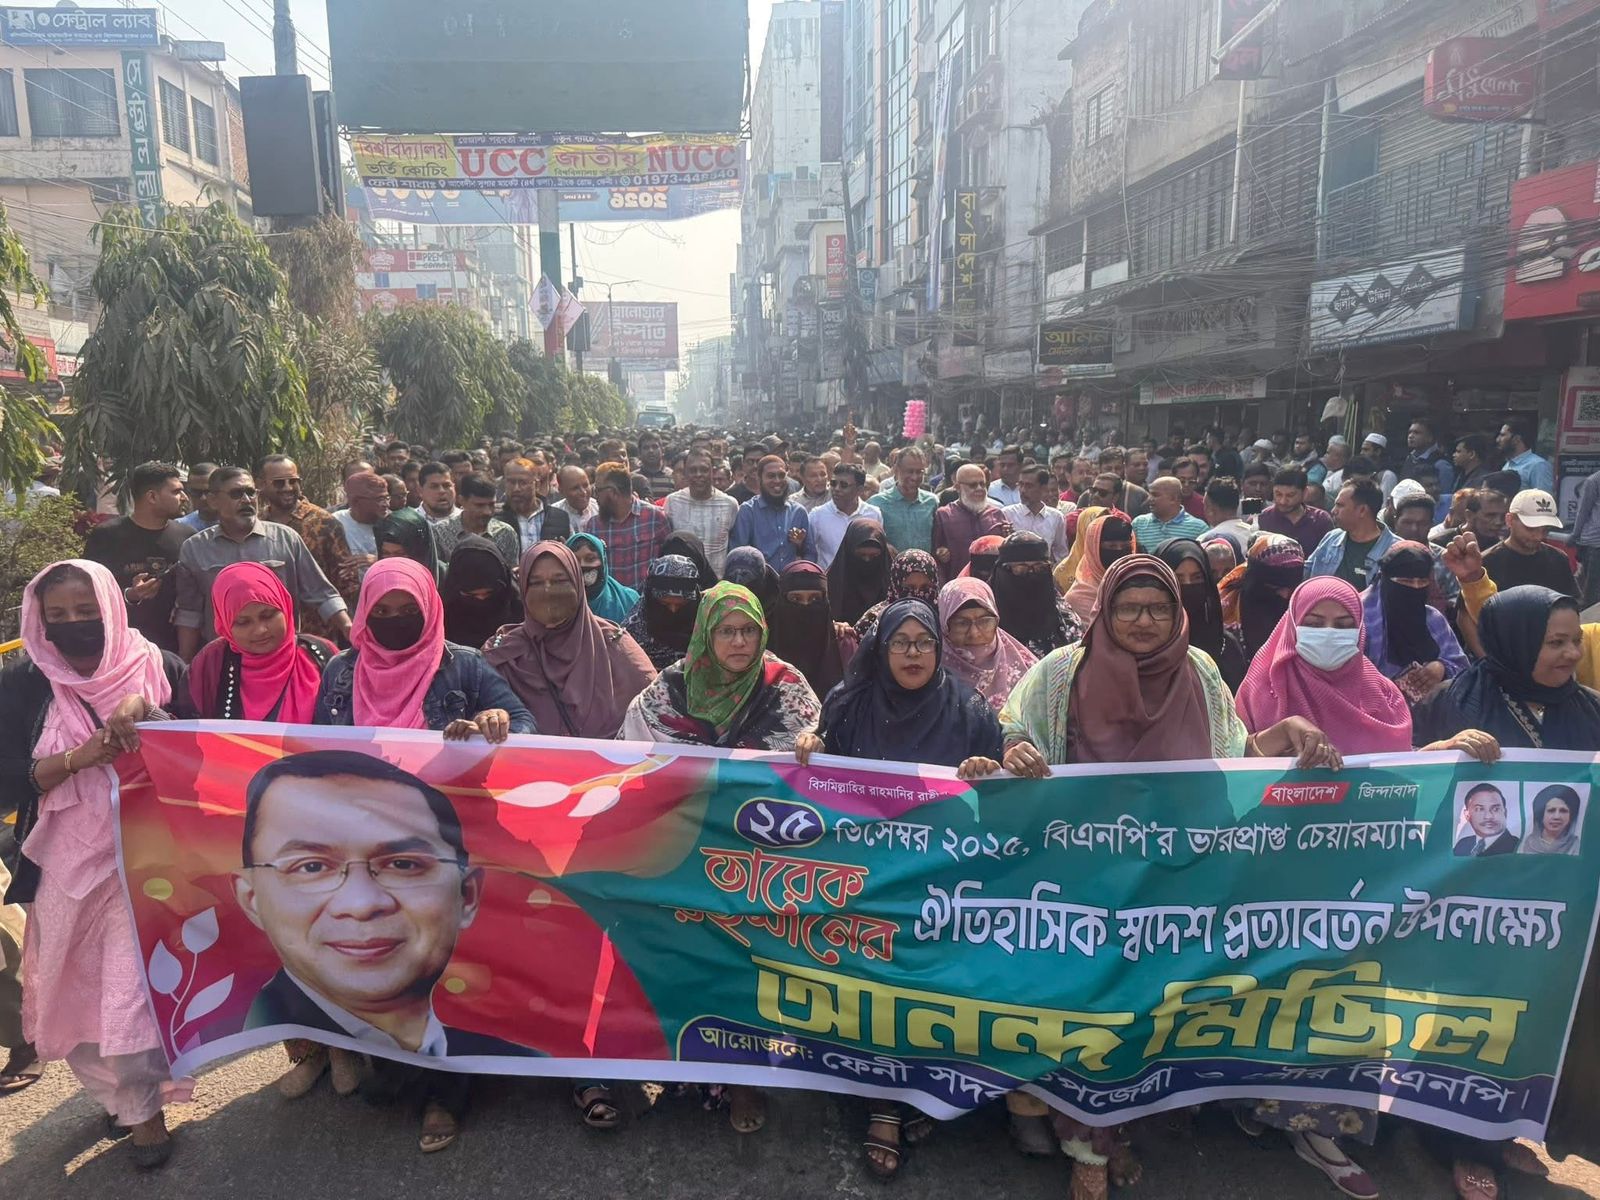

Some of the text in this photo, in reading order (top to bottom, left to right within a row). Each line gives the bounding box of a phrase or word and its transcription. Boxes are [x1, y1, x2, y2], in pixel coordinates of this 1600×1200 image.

[53, 9, 152, 31] সেন্ট্রাল ল্যাব
[355, 135, 448, 160] বিশ্ববিদ্যালয়
[554, 145, 639, 167] জাতীয়
[646, 144, 736, 173] NUCC
[366, 161, 450, 177] ভর্তি কোচিং
[457, 147, 547, 177] UCC
[368, 177, 399, 188] ফেনী
[808, 776, 865, 795] বিসমিল্লাহির
[868, 785, 914, 801] রাহমানির
[1271, 781, 1420, 803] বাংলাদেশ জিন্দাবাদ
[749, 802, 817, 846] ২৫
[1185, 822, 1291, 856] ভারপ্রাপ্ত
[1297, 816, 1432, 852] চেয়ারম্যান
[699, 847, 870, 915] তারেক
[913, 879, 1109, 957] ঐতিহাসিক
[1115, 905, 1218, 962] স্বদেশ
[1222, 878, 1395, 960] প্রত্যাবর্তন
[751, 953, 1528, 1072] আনন্দ মিছিল
[822, 1051, 914, 1082] ফেনী
